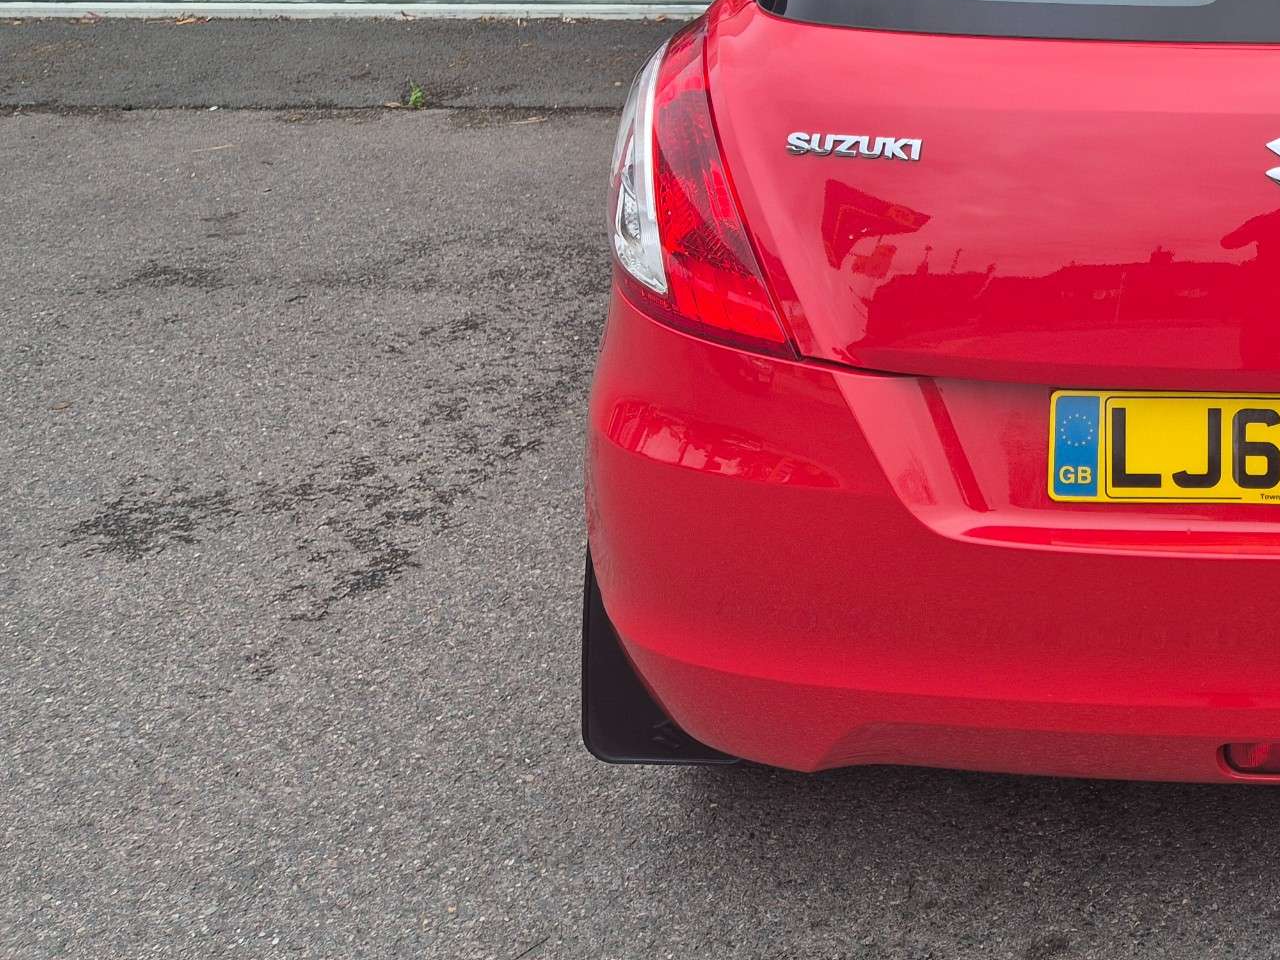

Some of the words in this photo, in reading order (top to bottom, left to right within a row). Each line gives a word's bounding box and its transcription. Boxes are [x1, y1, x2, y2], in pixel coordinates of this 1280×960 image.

[786, 131, 922, 161] SUZUKI
[1058, 465, 1092, 485] GB
[1260, 493, 1280, 501] Town
